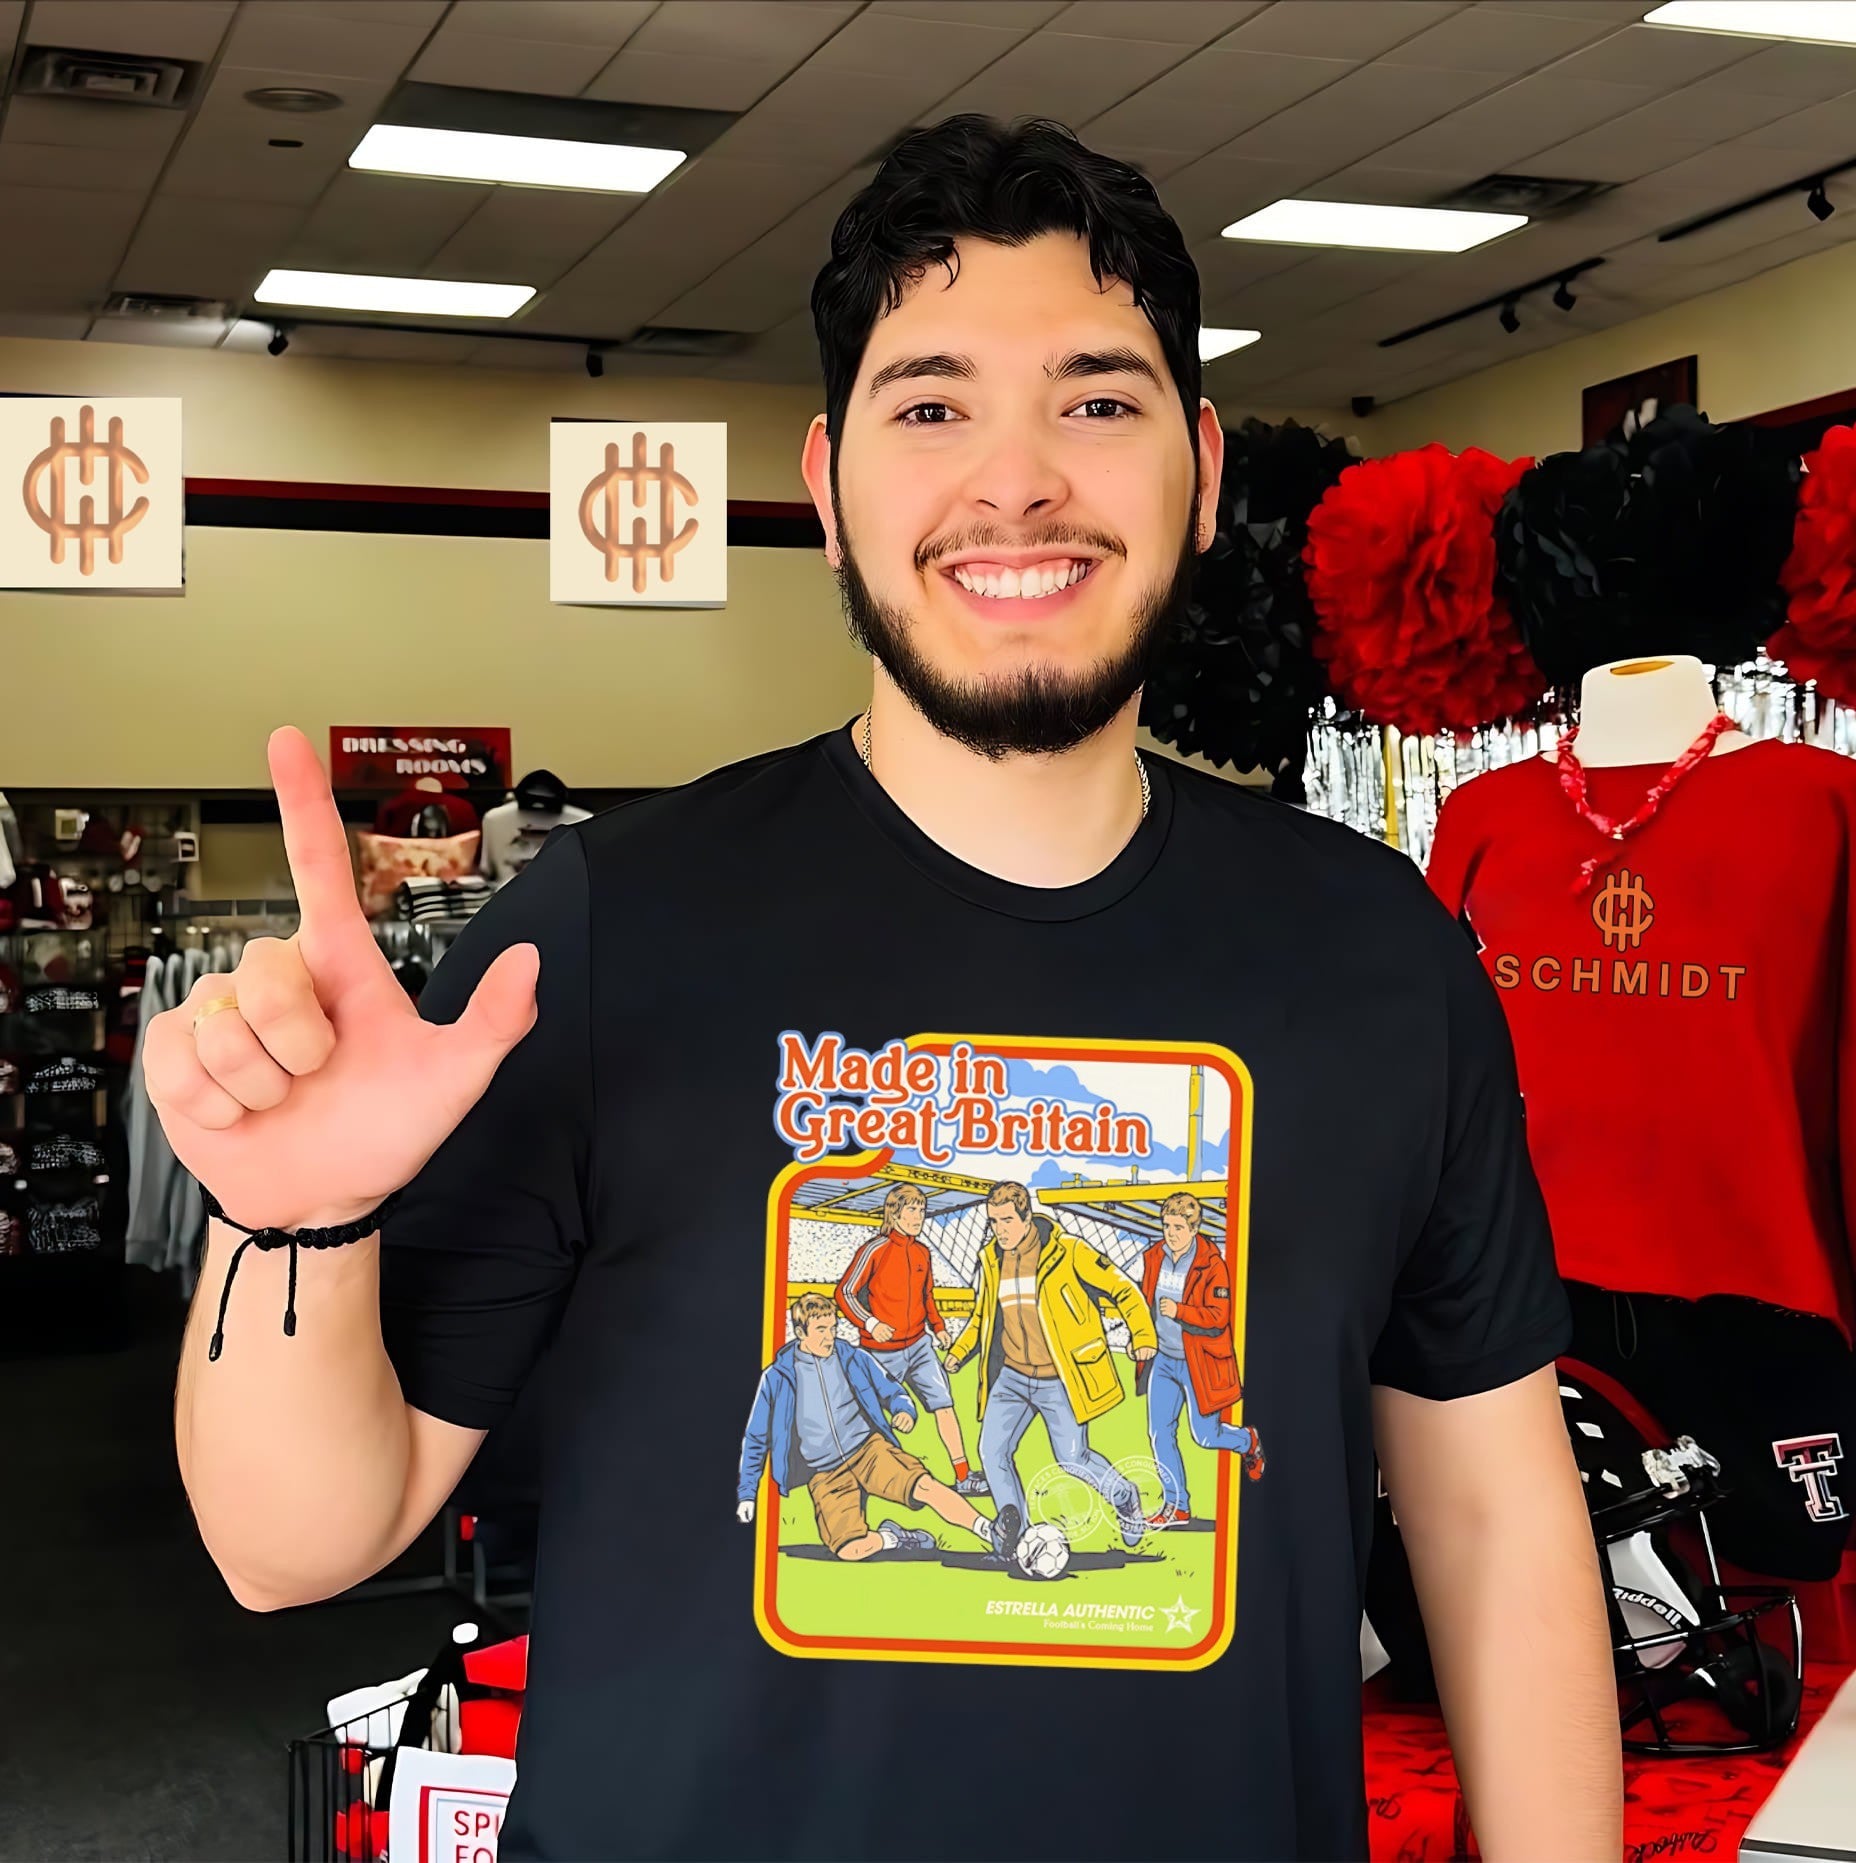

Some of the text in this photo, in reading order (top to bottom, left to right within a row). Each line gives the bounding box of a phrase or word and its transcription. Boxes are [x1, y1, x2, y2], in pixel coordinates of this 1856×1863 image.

[396, 759, 487, 774] ROOMS
[1495, 954, 1746, 1000] SCHMIDT
[781, 1036, 1008, 1104] Made in
[779, 1092, 1149, 1162] Great Britain
[985, 1600, 1155, 1620] ESTRELLA AUTHENTIC
[1088, 1621, 1124, 1632] Coming
[1127, 1622, 1153, 1632] Home
